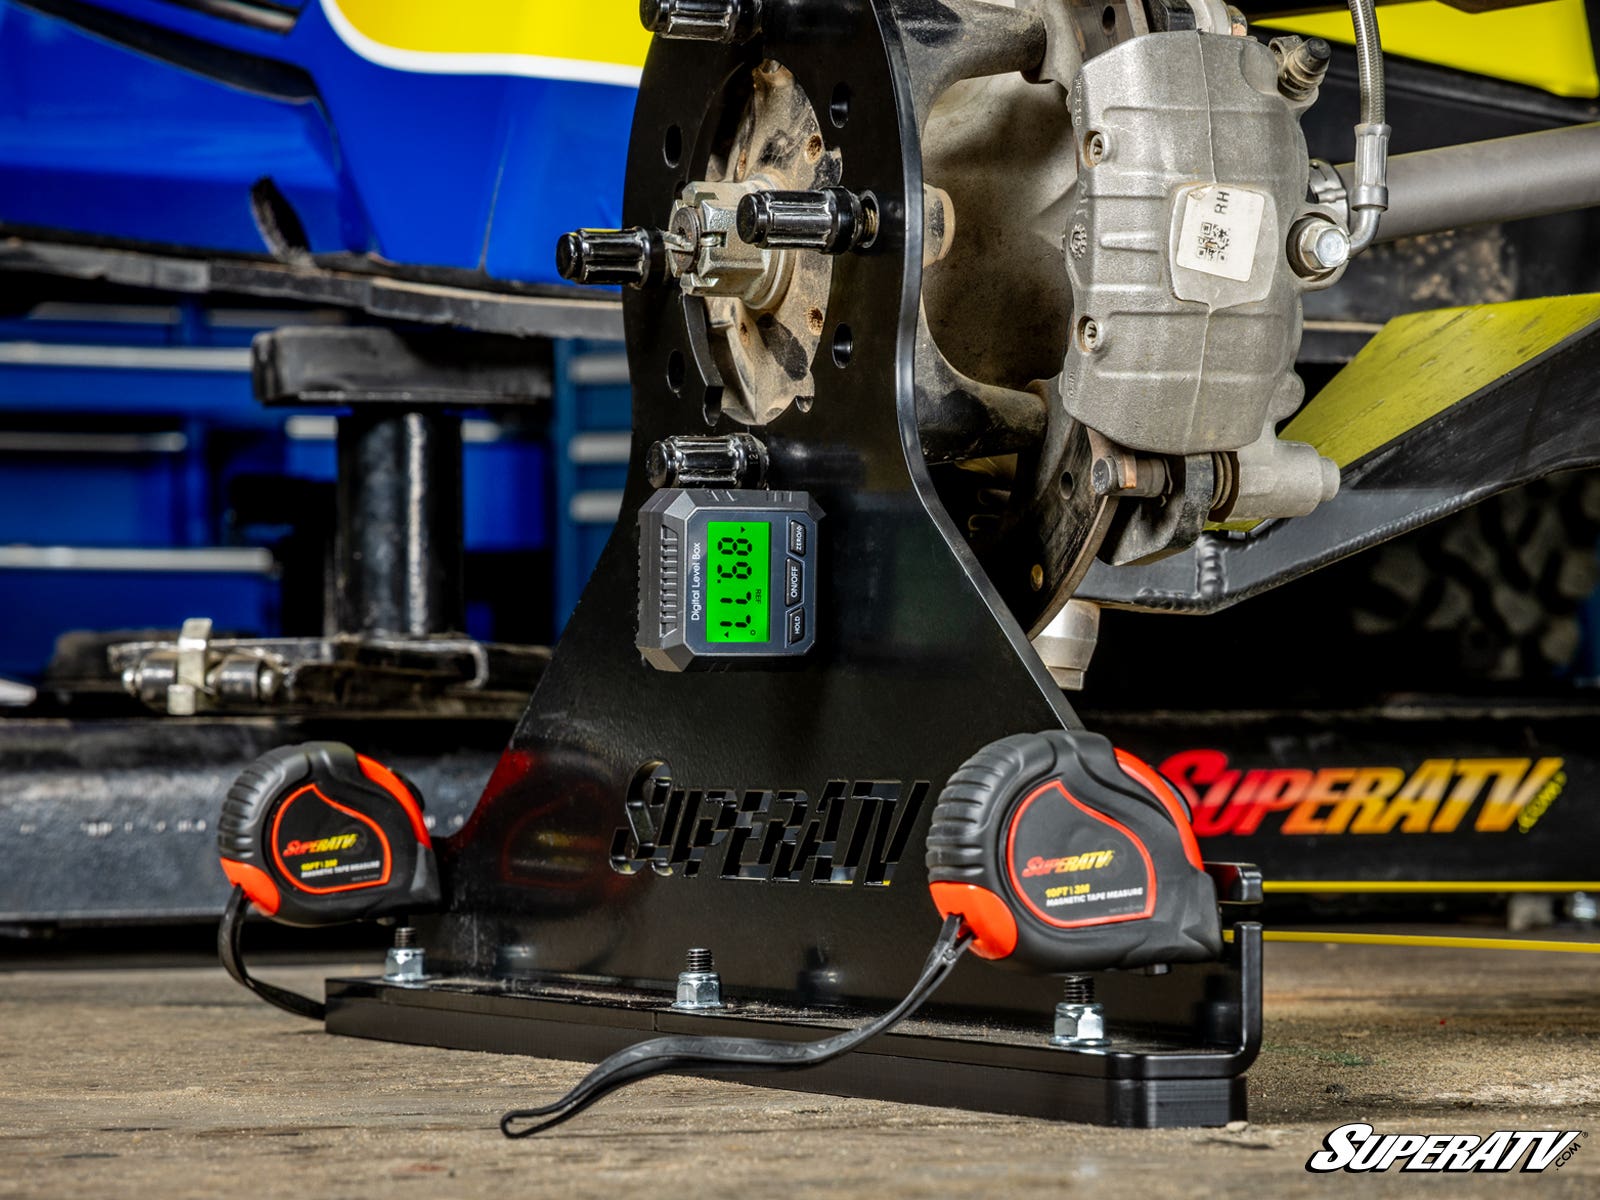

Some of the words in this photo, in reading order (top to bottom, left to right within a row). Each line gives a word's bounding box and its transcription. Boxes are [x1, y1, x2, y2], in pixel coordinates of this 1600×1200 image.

[1214, 191, 1230, 215] RH
[692, 542, 701, 560] Box
[692, 562, 701, 588] Level
[790, 565, 799, 598] ON/OFF
[691, 590, 702, 621] Digital
[1046, 895, 1086, 907] MAGNETIC
[1086, 892, 1106, 902] TAPE
[1106, 887, 1143, 899] MEASURE
